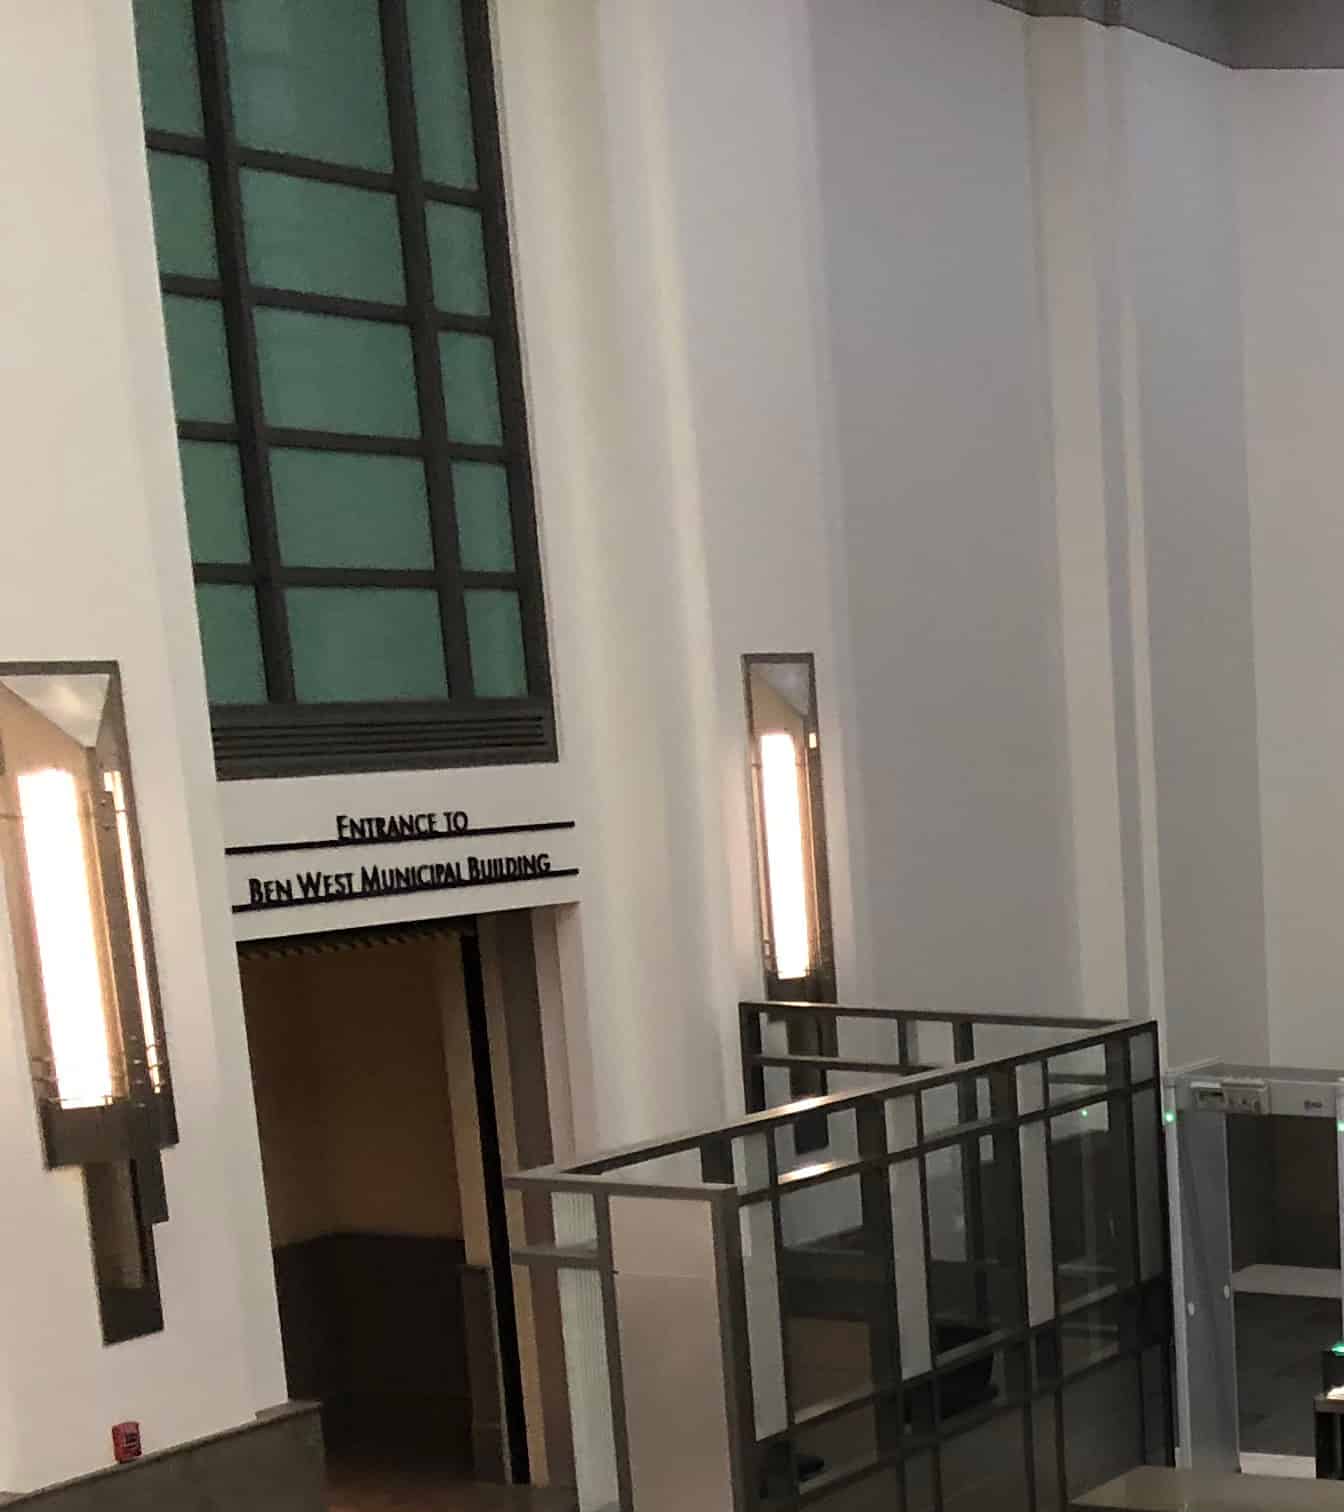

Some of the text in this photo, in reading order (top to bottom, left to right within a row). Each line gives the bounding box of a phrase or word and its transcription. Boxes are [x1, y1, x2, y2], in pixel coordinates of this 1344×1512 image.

[336, 811, 469, 840] ENTRANCE TO
[248, 853, 551, 905] BEN WEST MUNICIPAL BUILDING
